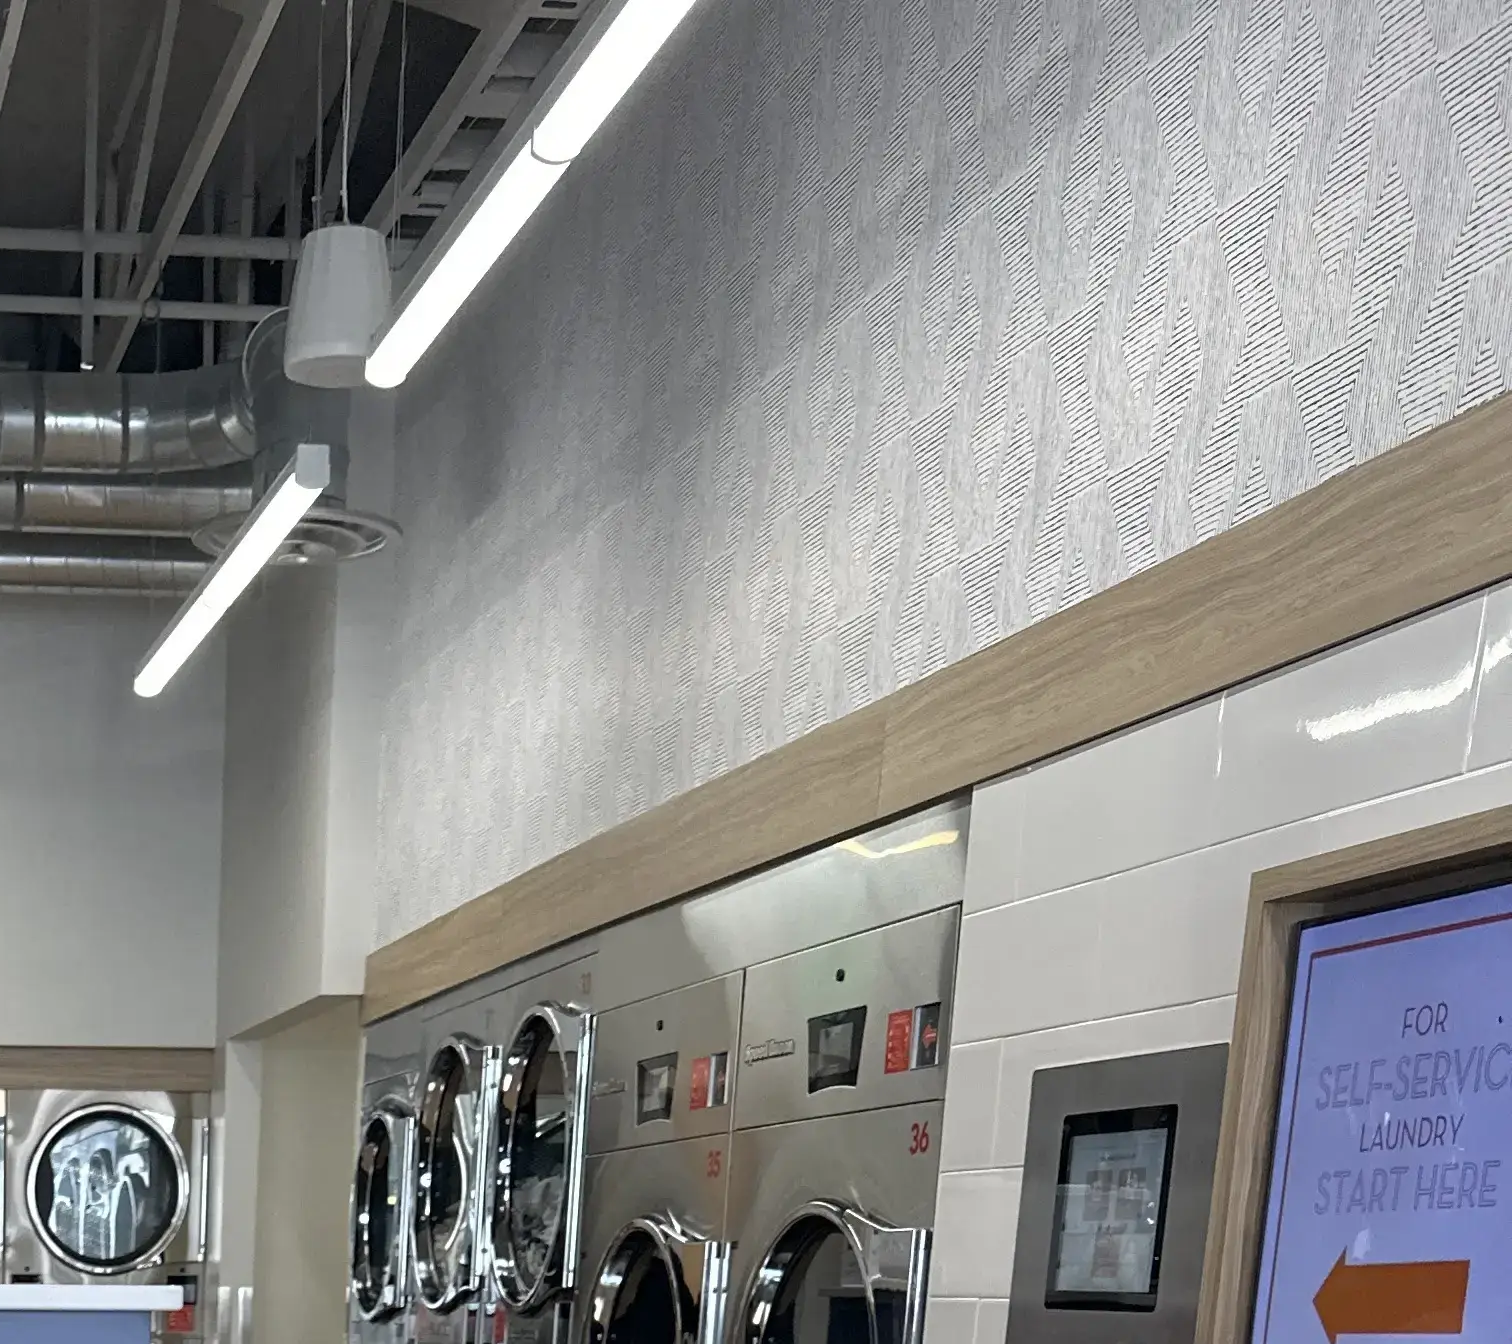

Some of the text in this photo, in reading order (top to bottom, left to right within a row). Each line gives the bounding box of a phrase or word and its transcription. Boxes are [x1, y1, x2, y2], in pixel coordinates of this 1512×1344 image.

[1401, 1001, 1449, 1039] FOR
[1315, 1042, 1512, 1111] SELF-SERVIC
[909, 1121, 929, 1156] 36
[1359, 1112, 1466, 1153] LAUNDRY
[1313, 1159, 1501, 1216] START HERE
